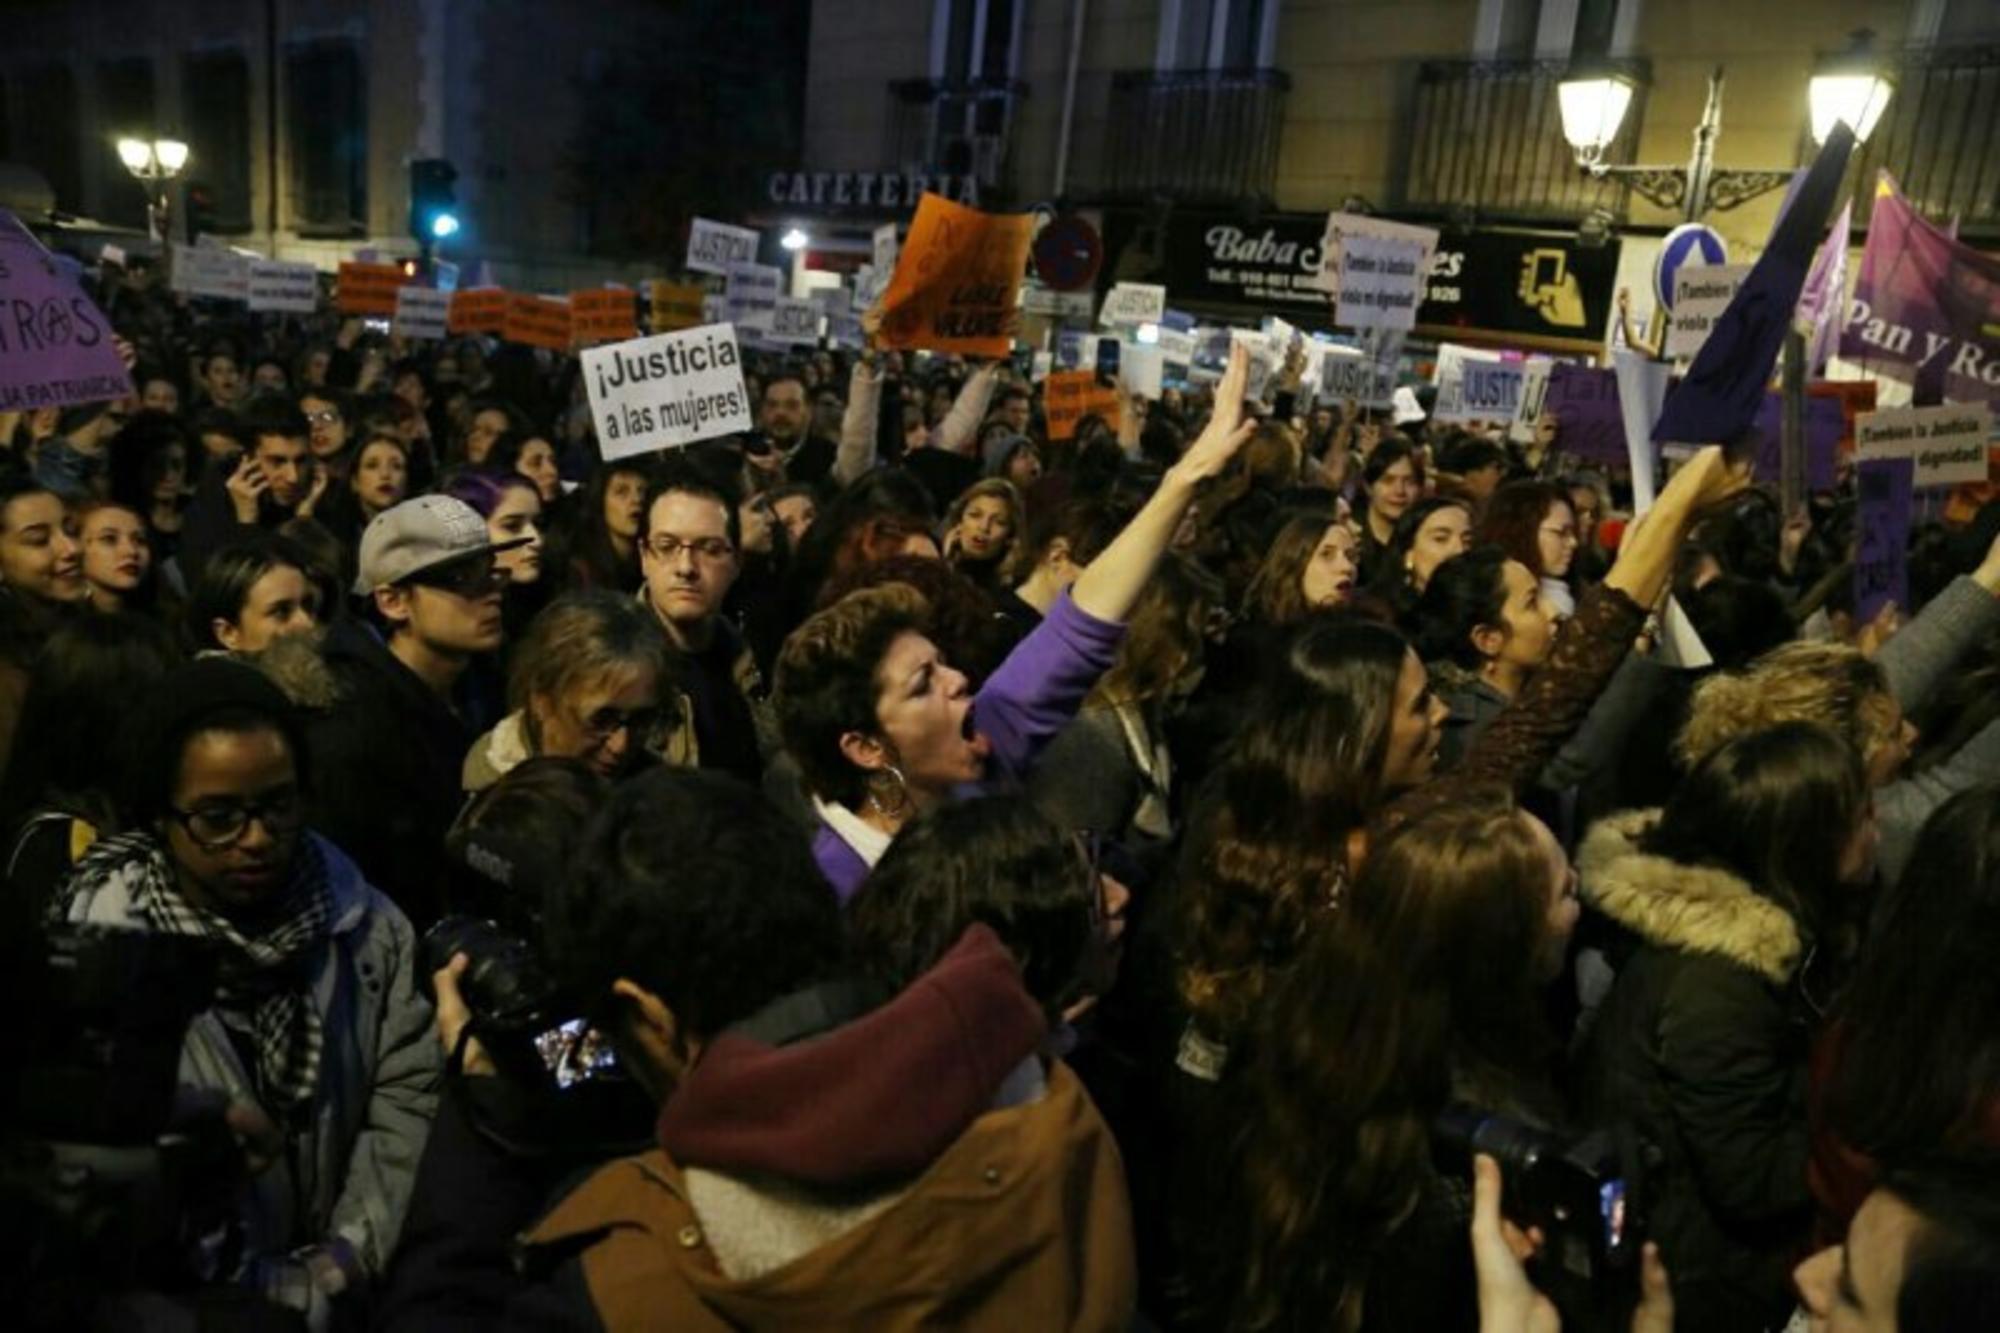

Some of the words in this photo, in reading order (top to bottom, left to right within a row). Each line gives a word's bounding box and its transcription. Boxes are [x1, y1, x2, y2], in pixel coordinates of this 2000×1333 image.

[1205, 226, 1298, 264] Baba
[1842, 299, 1913, 354] Pan
[1917, 332, 1949, 368] y
[596, 336, 737, 398] ¡Justicia
[606, 412, 620, 440] a
[622, 404, 655, 436] las
[659, 381, 747, 432] mujeres!
